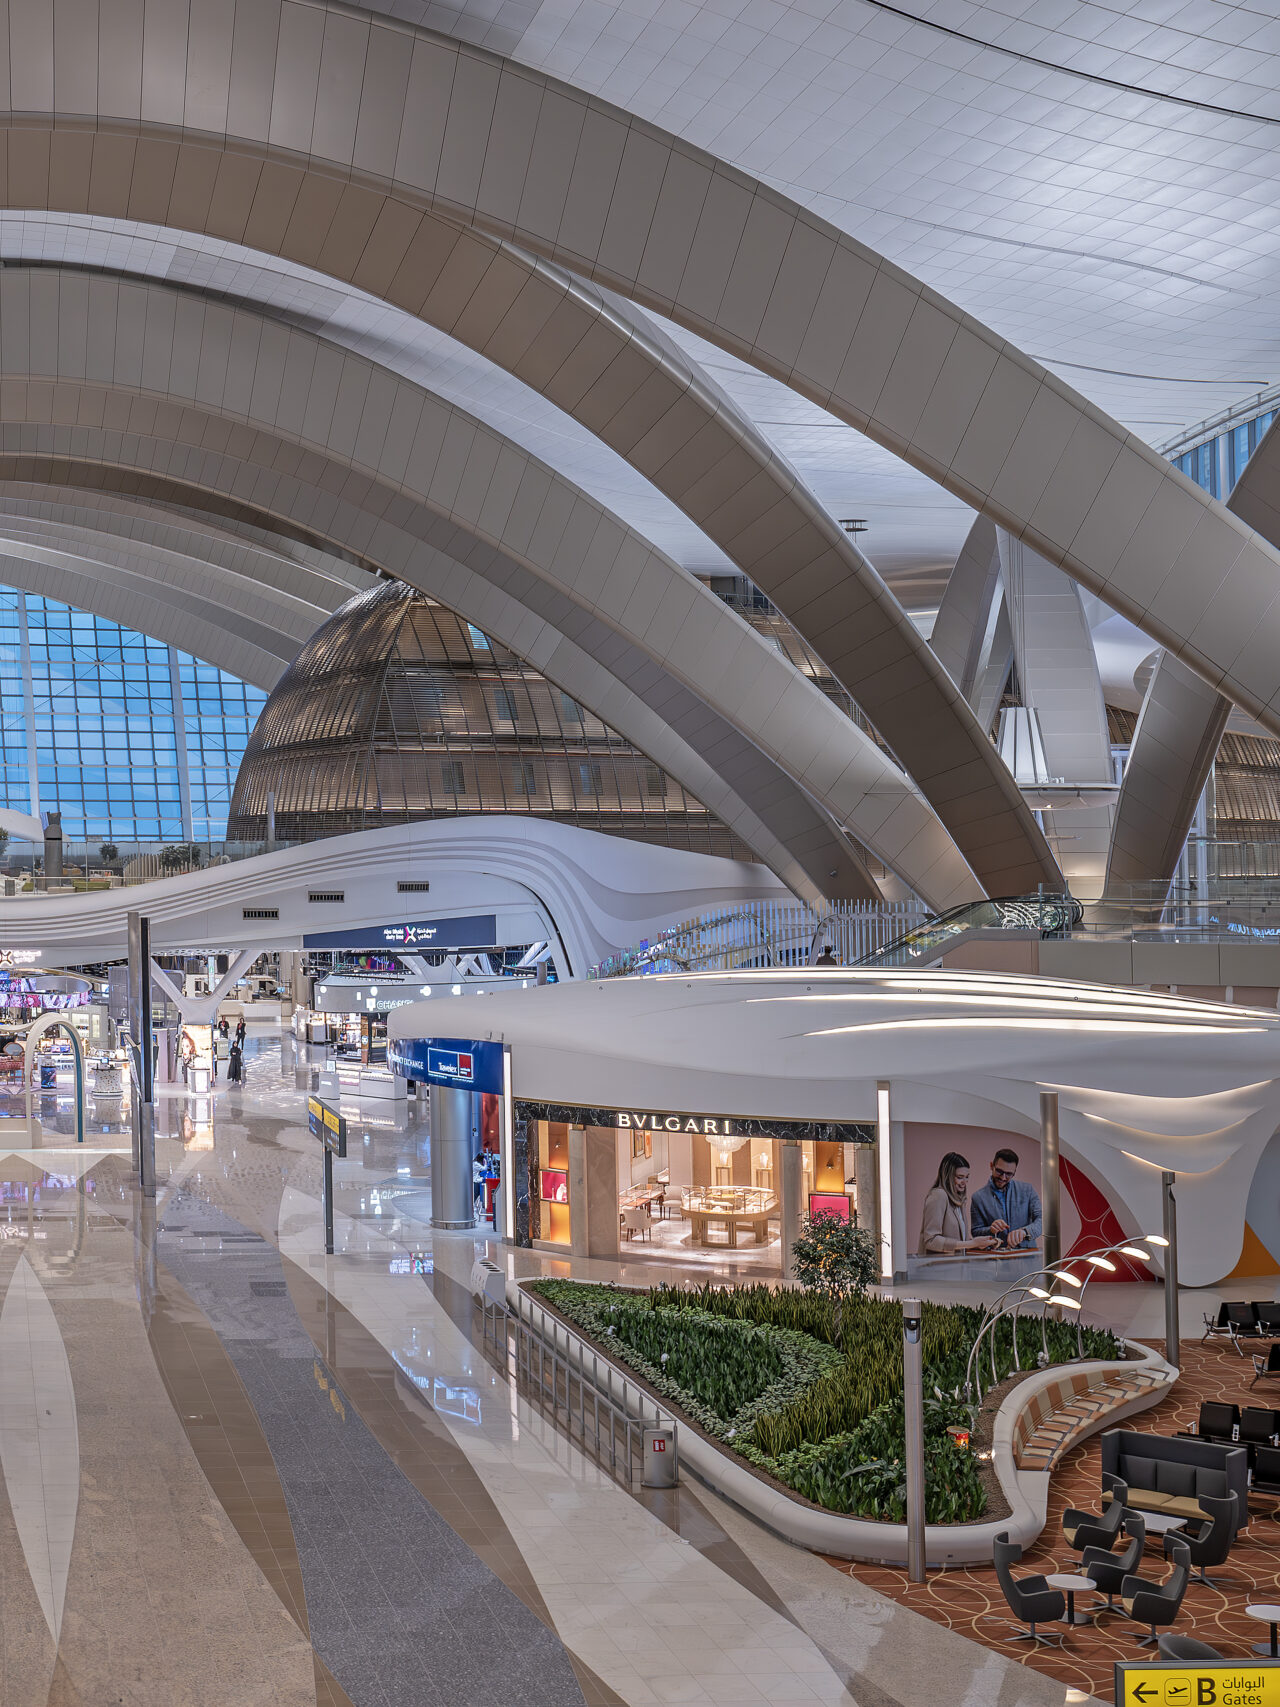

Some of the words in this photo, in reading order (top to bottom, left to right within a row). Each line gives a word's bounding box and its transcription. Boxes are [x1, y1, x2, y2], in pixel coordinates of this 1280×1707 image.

[438, 1061, 458, 1074] Travelex
[617, 1113, 730, 1135] BVLGARI
[1197, 1677, 1217, 1706] B
[1222, 1676, 1265, 1692] البوابات
[1222, 1693, 1262, 1706] Gates
